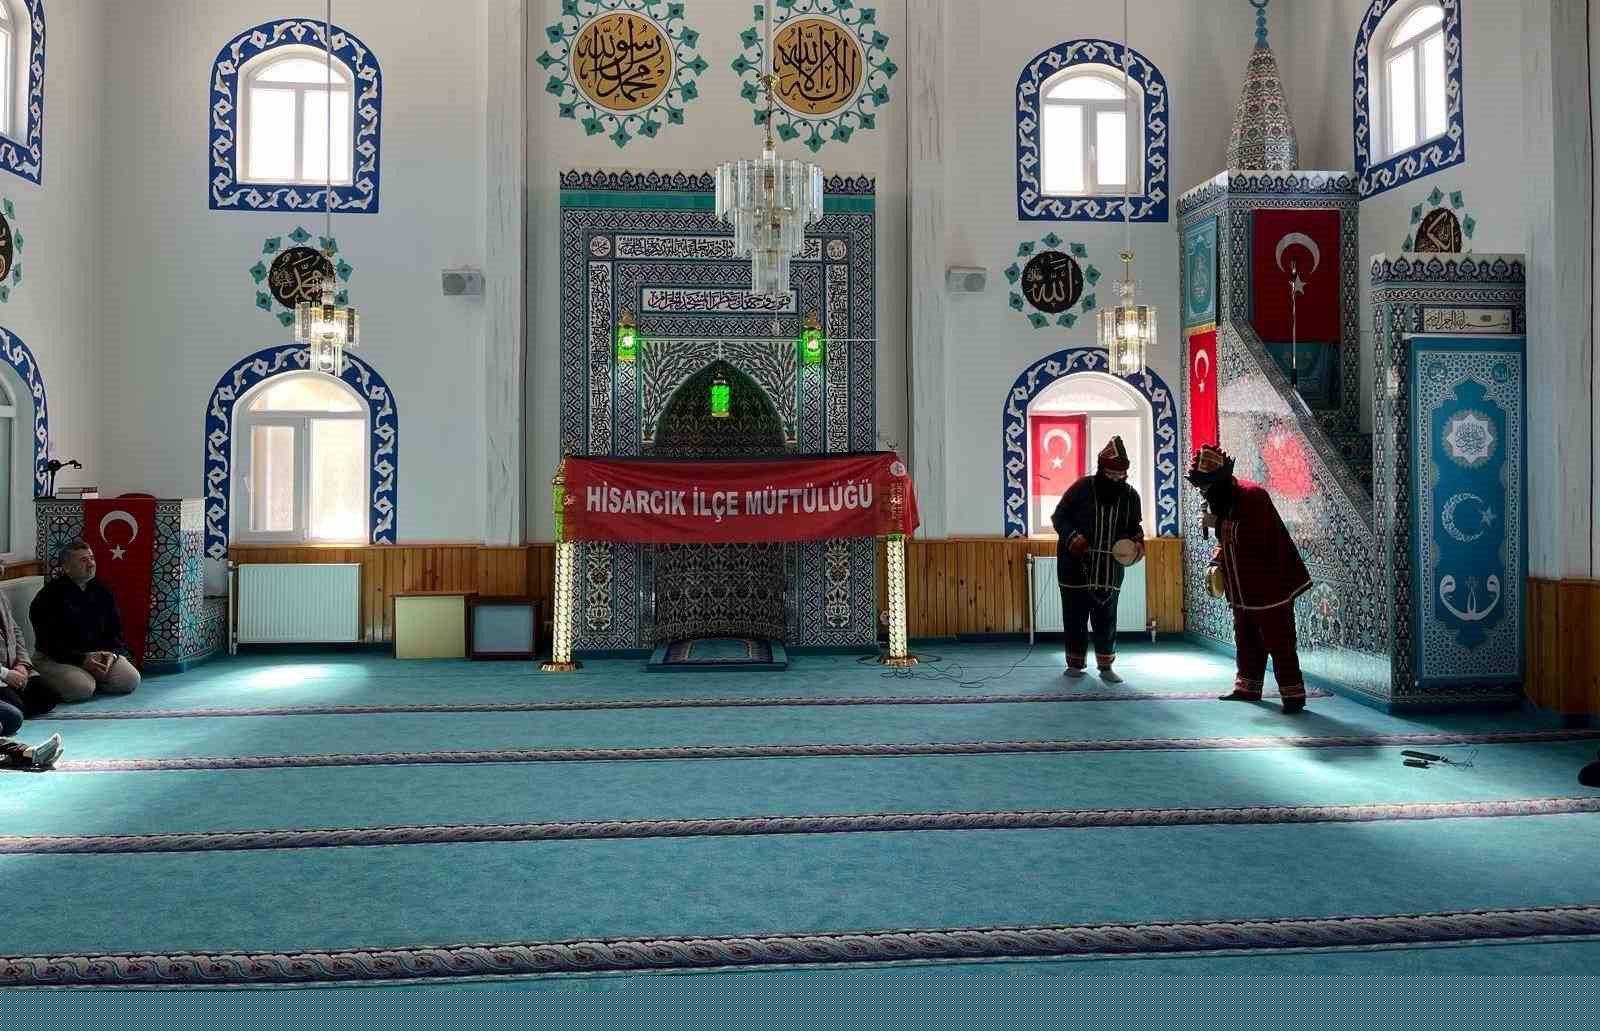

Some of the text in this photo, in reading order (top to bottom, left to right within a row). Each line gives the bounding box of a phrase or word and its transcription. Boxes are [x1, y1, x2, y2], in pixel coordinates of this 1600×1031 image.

[1032, 259, 1073, 304] الله
[586, 478, 873, 523] HİSARCIK İLÇE MÜFTÜLÜĞÜ
